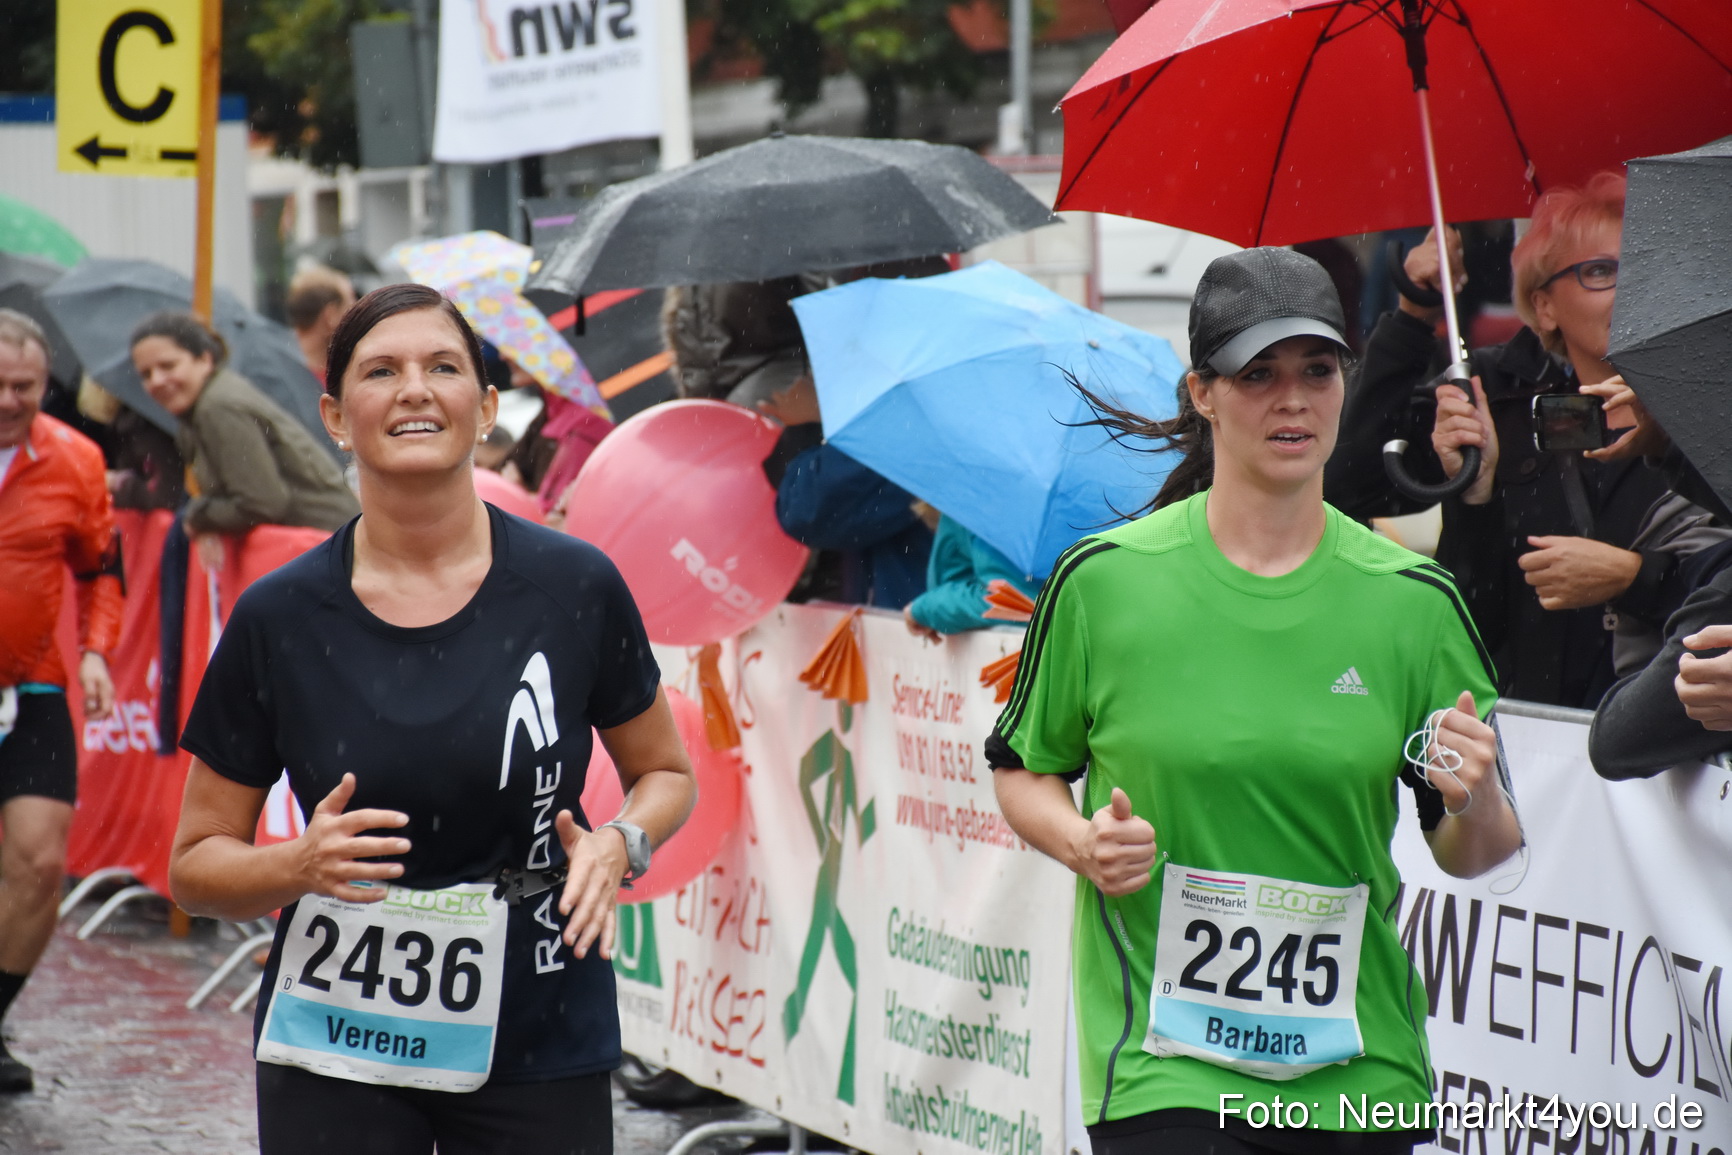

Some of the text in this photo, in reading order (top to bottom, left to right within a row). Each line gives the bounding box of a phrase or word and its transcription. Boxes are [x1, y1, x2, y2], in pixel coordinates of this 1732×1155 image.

[98, 10, 175, 123] C
[1330, 684, 1369, 696] adidas
[958, 743, 977, 784] 52
[384, 885, 489, 917] BOCK
[1181, 889, 1248, 909] NeuerMarkt
[1257, 884, 1349, 917] BOCK
[415, 912, 426, 922] by
[427, 915, 452, 924] smart
[453, 918, 489, 928] concepts
[1255, 909, 1285, 921] inspired
[1287, 912, 1297, 922] by
[1298, 914, 1321, 924] smart
[298, 914, 484, 1012] 2436
[1179, 919, 1342, 1007] 2245
[1397, 882, 1483, 1025] MW
[283, 977, 293, 990] D
[1163, 981, 1172, 995] D
[326, 1015, 427, 1059] Verena
[1205, 1016, 1308, 1056] Barbara
